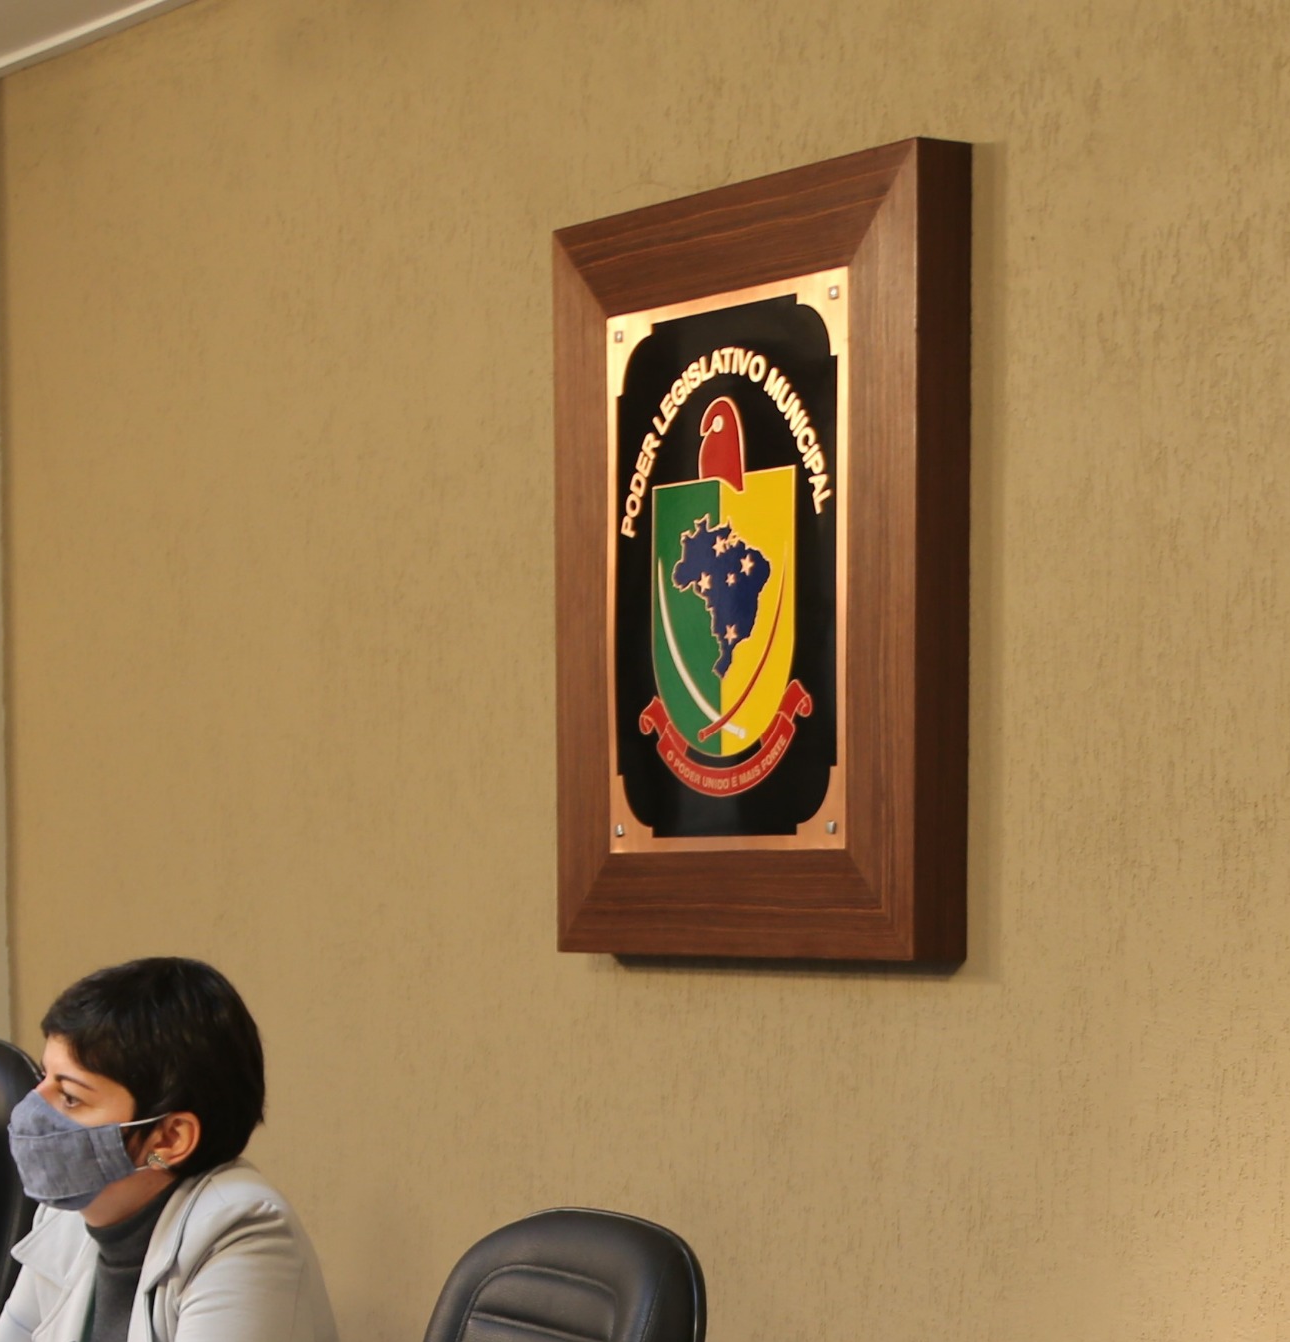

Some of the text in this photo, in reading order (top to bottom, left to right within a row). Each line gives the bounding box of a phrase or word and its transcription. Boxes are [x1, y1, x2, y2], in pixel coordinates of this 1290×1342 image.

[620, 346, 832, 539] PODER LEGISLATIVO MUNICIPAL
[673, 759, 701, 785] PODER
[702, 776, 730, 790] UNIDO
[739, 764, 761, 785] MAIS
